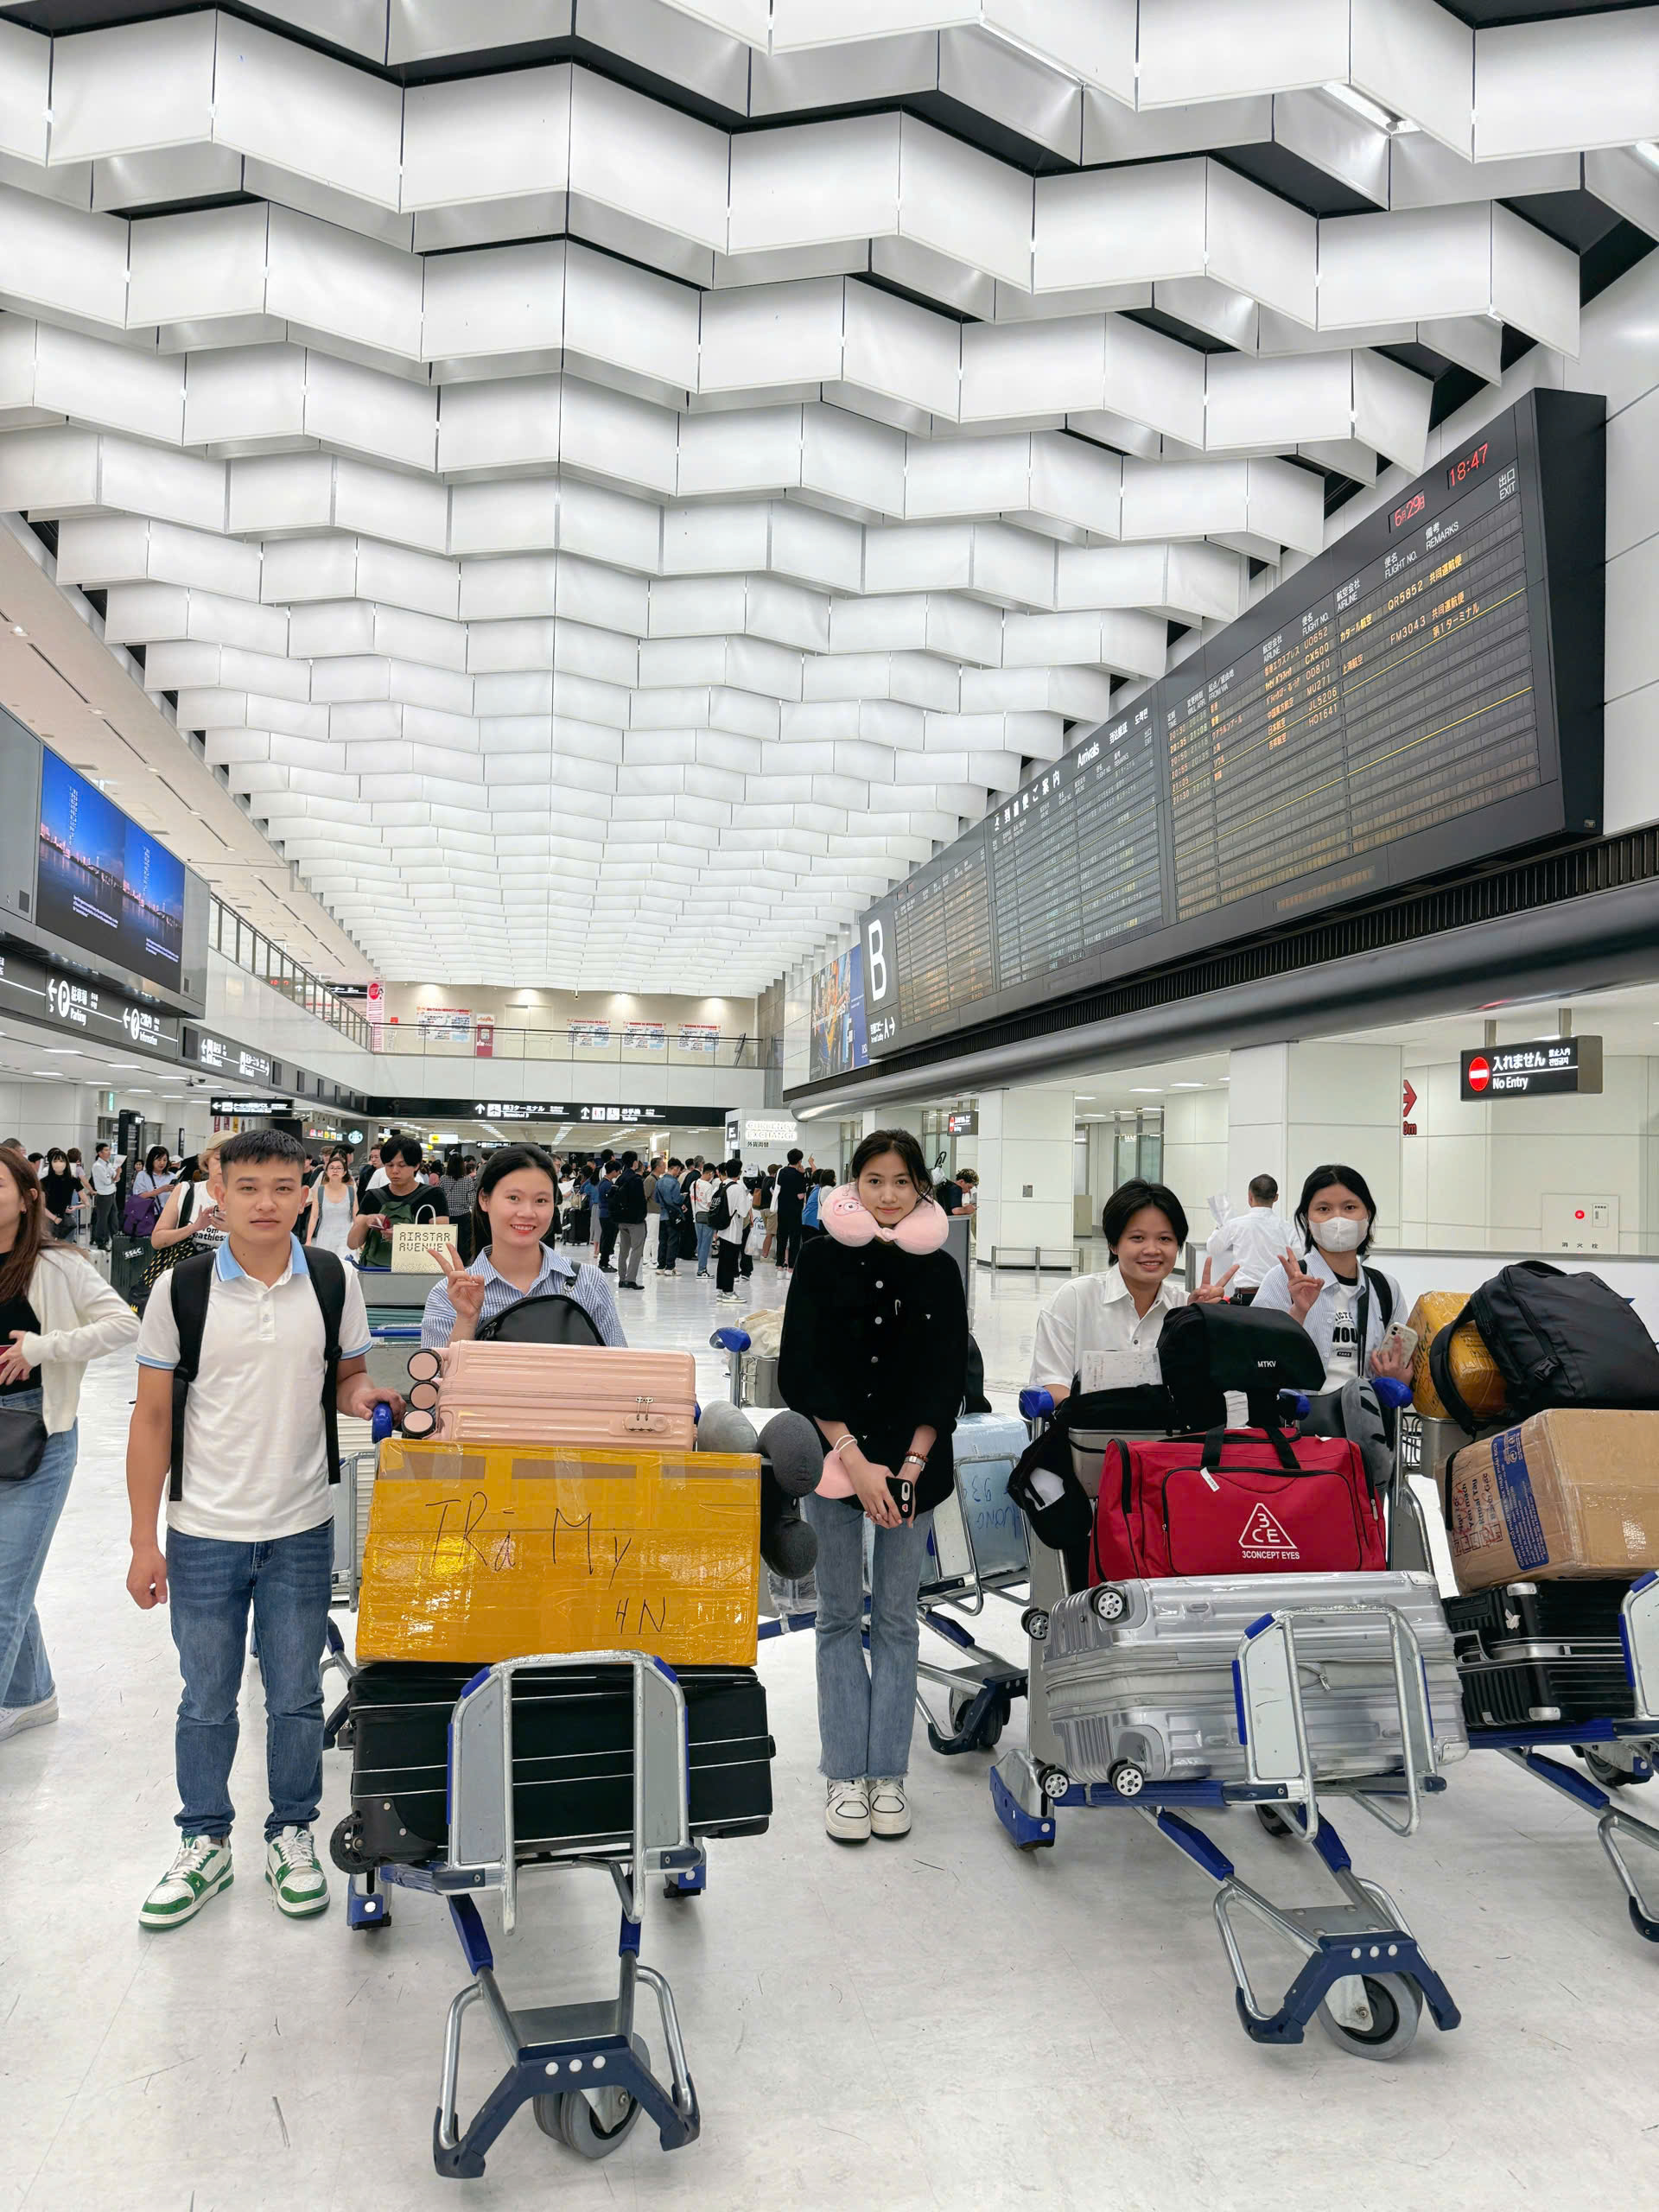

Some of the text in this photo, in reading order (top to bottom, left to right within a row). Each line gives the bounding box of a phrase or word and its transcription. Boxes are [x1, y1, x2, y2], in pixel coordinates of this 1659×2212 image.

[1449, 442, 1489, 486] 18:47
[1498, 467, 1516, 490] 出口
[1499, 480, 1516, 501] EXIT
[1425, 521, 1440, 540] 備考
[1426, 521, 1459, 551] REMARKS
[1384, 550, 1418, 579] FLIGHT NO.
[1428, 553, 1463, 585] 共同運航便
[1336, 578, 1361, 602] 航空会社
[1388, 580, 1423, 612] QR5852
[1337, 591, 1358, 613] AIRLINE
[1302, 619, 1319, 637] FLIGHT
[1339, 613, 1374, 644] カタール航空
[1390, 614, 1426, 645] FM3043
[1263, 647, 1281, 664] AIRLINE
[1305, 642, 1330, 665] CX500
[1306, 674, 1331, 697] MU271
[1308, 686, 1338, 712] JL5206
[1077, 741, 1100, 769] Arrivals
[868, 918, 887, 1002] B
[70, 1007, 86, 1027] Parking
[1492, 1051, 1546, 1072] 入れません
[1492, 1076, 1529, 1090] No Entry
[746, 1121, 797, 1131] CURRENCY
[746, 1130, 798, 1141] EXCHANGE
[398, 1243, 444, 1253] AVENUE
[399, 1231, 451, 1242] AIRSTAR
[1257, 1360, 1277, 1369] MTKV
[1242, 1550, 1300, 1560] 3CONCEPT EYES
[614, 1597, 667, 1635] HN
